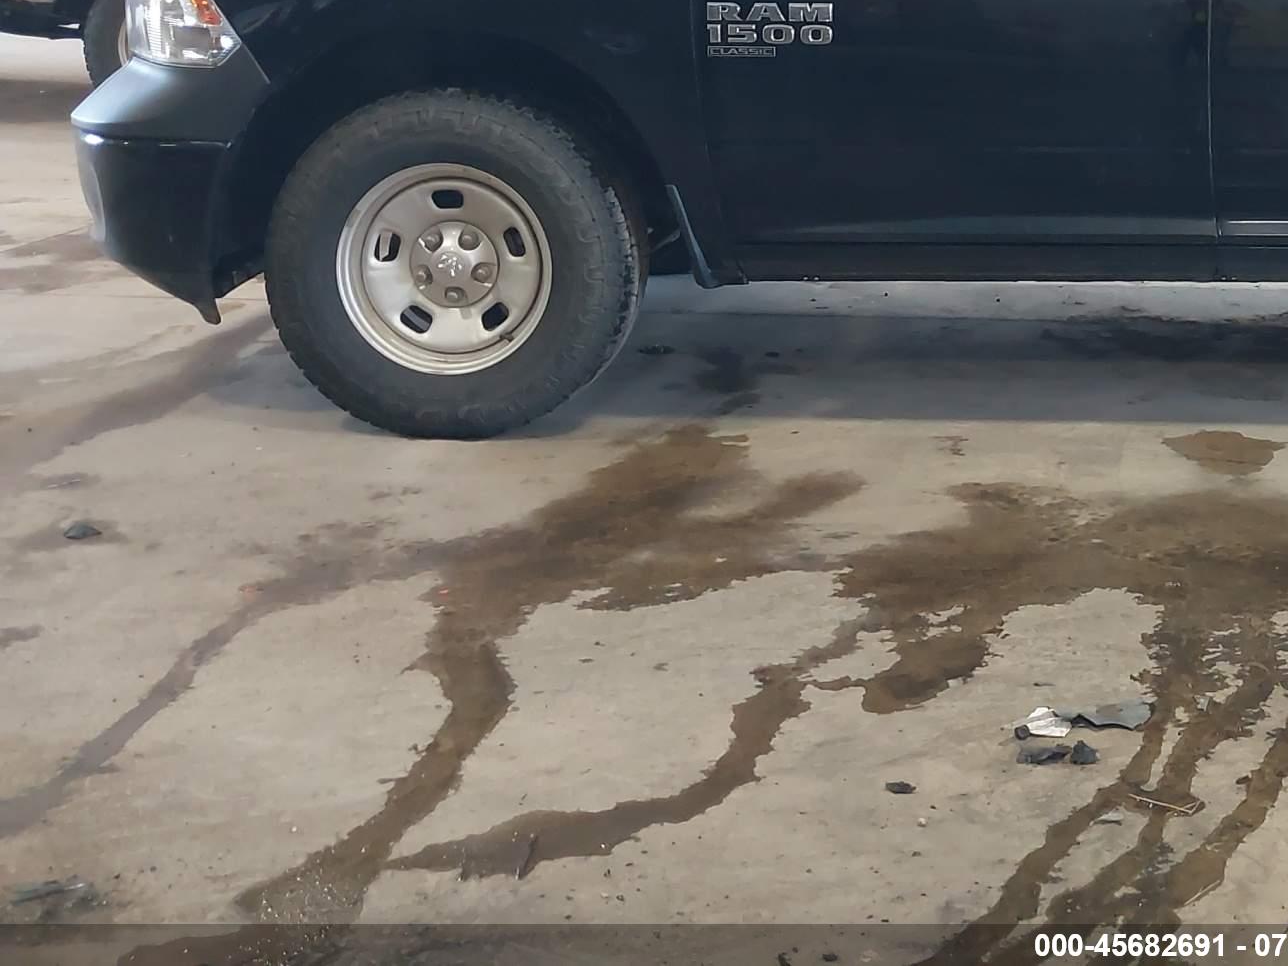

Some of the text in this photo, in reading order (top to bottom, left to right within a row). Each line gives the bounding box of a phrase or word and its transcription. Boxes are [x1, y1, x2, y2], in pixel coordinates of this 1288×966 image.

[706, 1, 833, 22] RAM
[706, 23, 833, 45] 1500
[708, 46, 774, 57] CLASSIC
